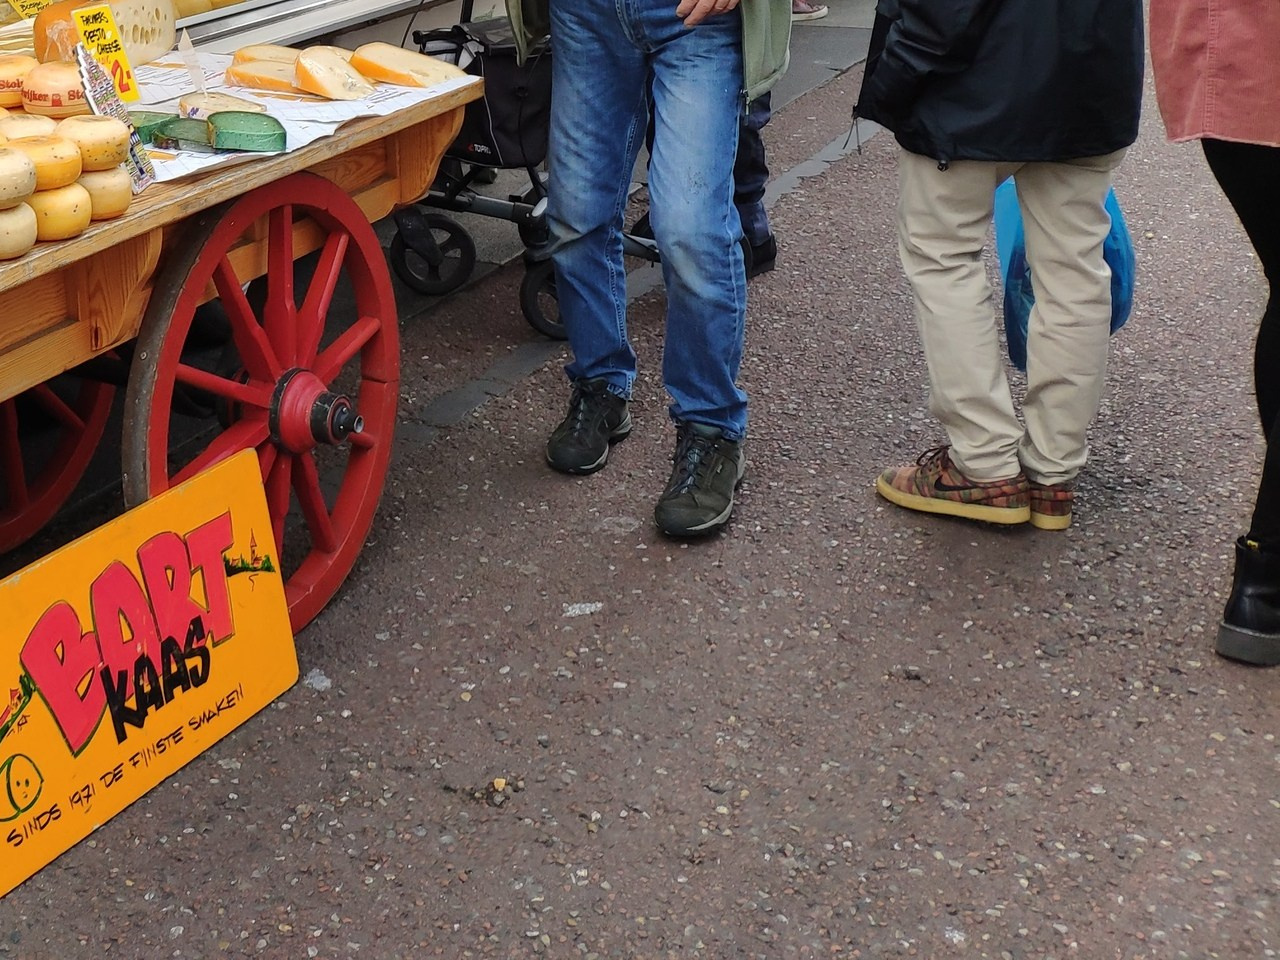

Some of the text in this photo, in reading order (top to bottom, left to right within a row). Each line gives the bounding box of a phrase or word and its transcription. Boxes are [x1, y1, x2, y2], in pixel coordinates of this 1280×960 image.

[97, 39, 121, 55] CHEESE
[20, 507, 235, 757] BART
[100, 615, 211, 744] KAAS
[6, 682, 244, 847] SINDS 1971 DE FIJNSTE SMAKEN
